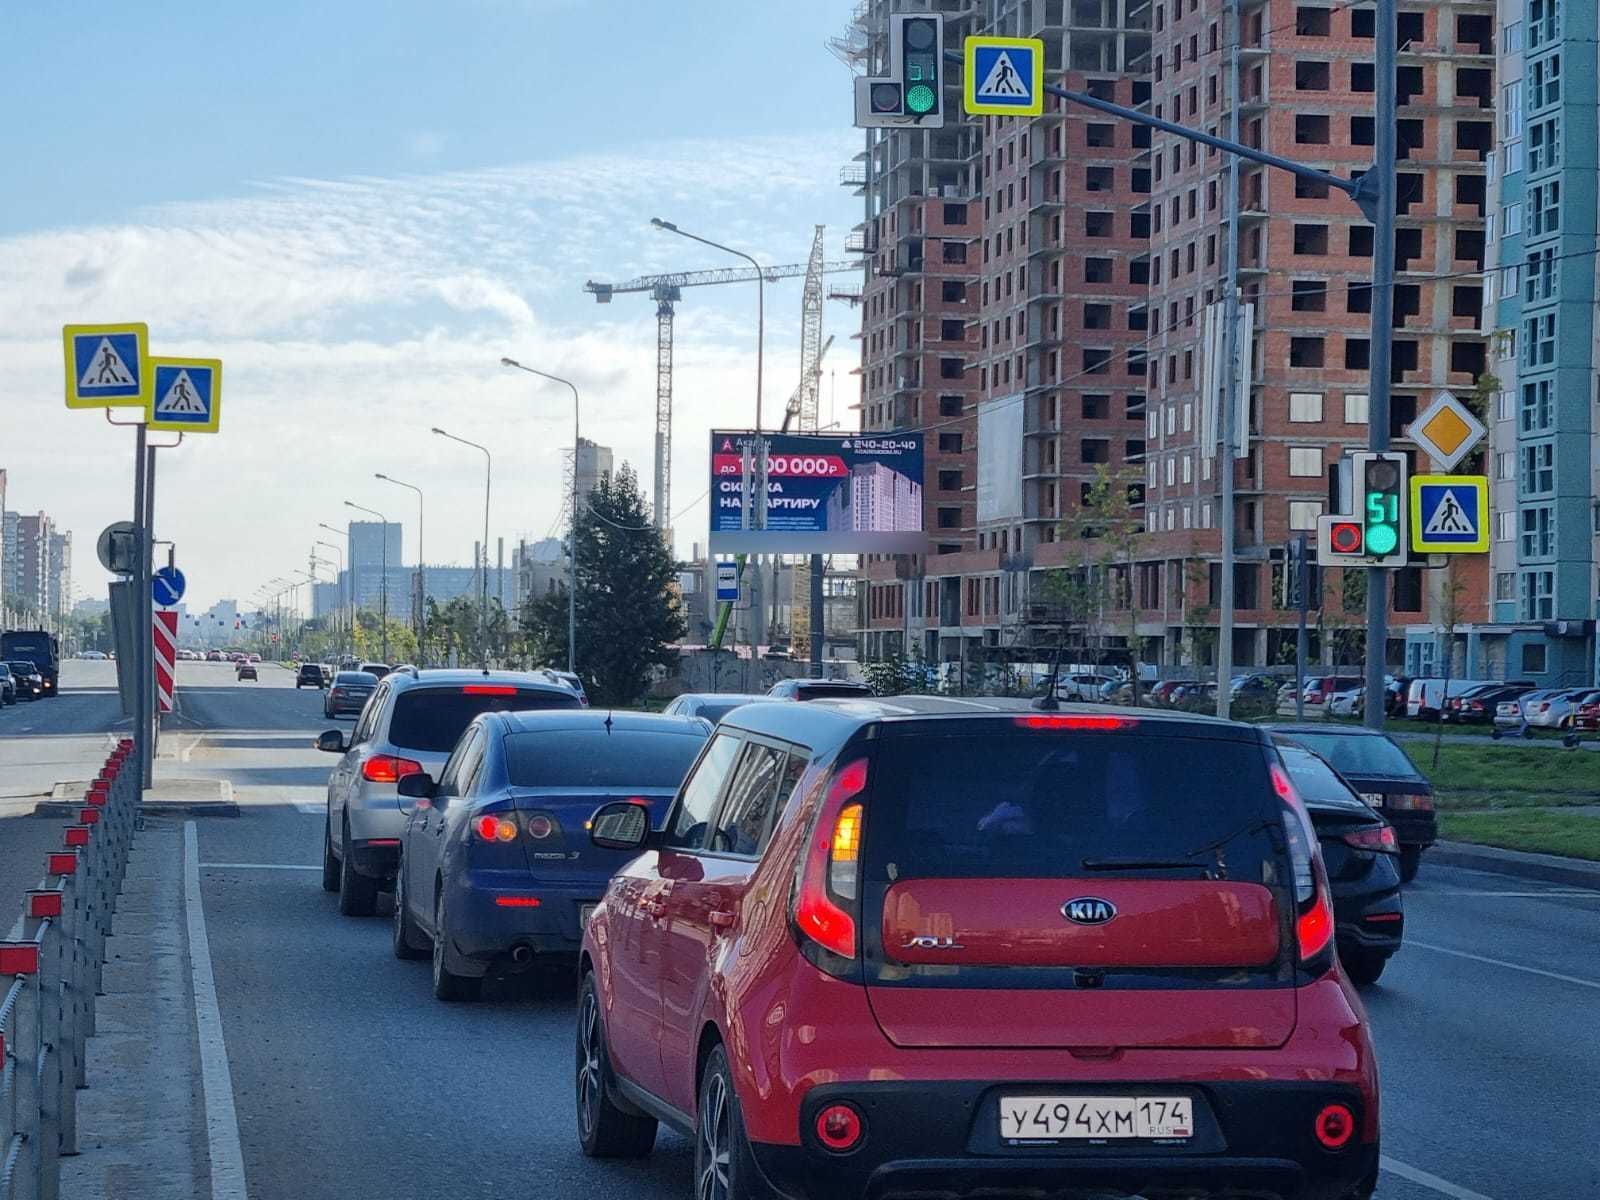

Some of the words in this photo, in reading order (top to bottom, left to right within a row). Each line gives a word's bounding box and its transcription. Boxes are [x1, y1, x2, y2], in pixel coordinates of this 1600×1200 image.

[854, 440, 916, 449] 240-20-40
[721, 466, 736, 474] до
[720, 498, 741, 508] НА
[1366, 492, 1398, 523] 51
[1071, 902, 1110, 920] KIA
[901, 936, 965, 948] SOUL
[1140, 1102, 1184, 1124] 174
[1150, 1127, 1172, 1135] RUS
